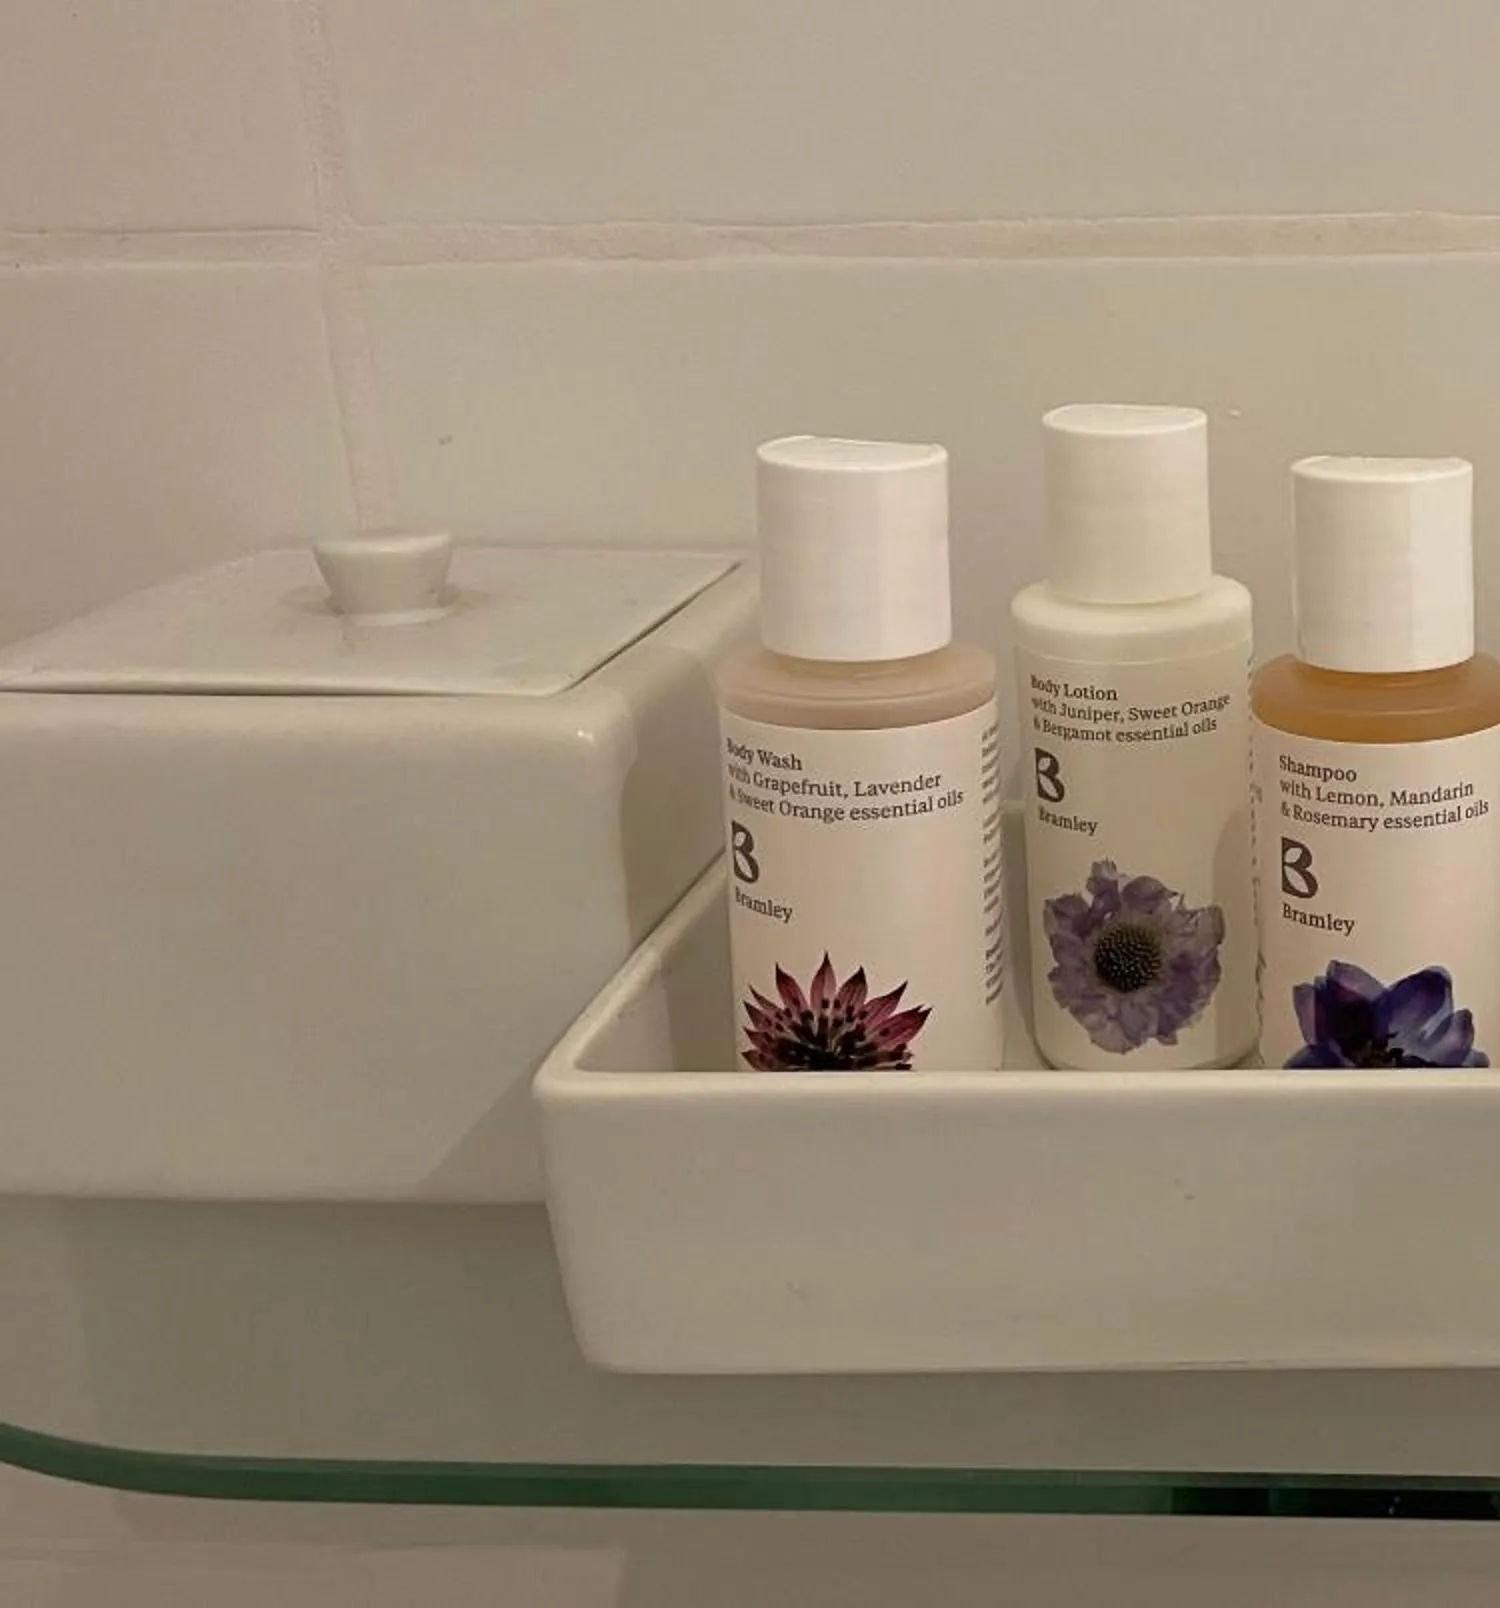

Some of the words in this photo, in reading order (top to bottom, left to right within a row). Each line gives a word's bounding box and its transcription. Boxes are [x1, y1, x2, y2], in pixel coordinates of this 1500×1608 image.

[1030, 674, 1060, 698] Body
[1064, 683, 1118, 701] Lotion
[1031, 698, 1057, 714] with
[1060, 703, 1125, 724] Juniper,
[1129, 704, 1177, 721] Sweet
[1181, 694, 1231, 717] Orange
[1043, 718, 1112, 741] Bergamot
[1116, 722, 1188, 743] essential
[1192, 717, 1217, 735] oils
[757, 749, 803, 771] Wash
[1279, 755, 1357, 783] Shampoo
[753, 771, 848, 800] Grapefruit,
[854, 773, 941, 798] Lavender
[1280, 778, 1311, 800] with
[1316, 786, 1385, 808] Lemon,
[1389, 781, 1474, 807] Mandarin
[779, 800, 845, 824] Orange
[849, 796, 933, 821] essential
[937, 789, 964, 809] oils
[1038, 806, 1098, 837] Bramley
[1281, 802, 1290, 817] &
[1293, 804, 1379, 832] Rosemary
[1383, 805, 1461, 829] essential
[1465, 800, 1489, 819] oils
[735, 886, 793, 923] Bramley
[1282, 901, 1355, 937] Bramley
